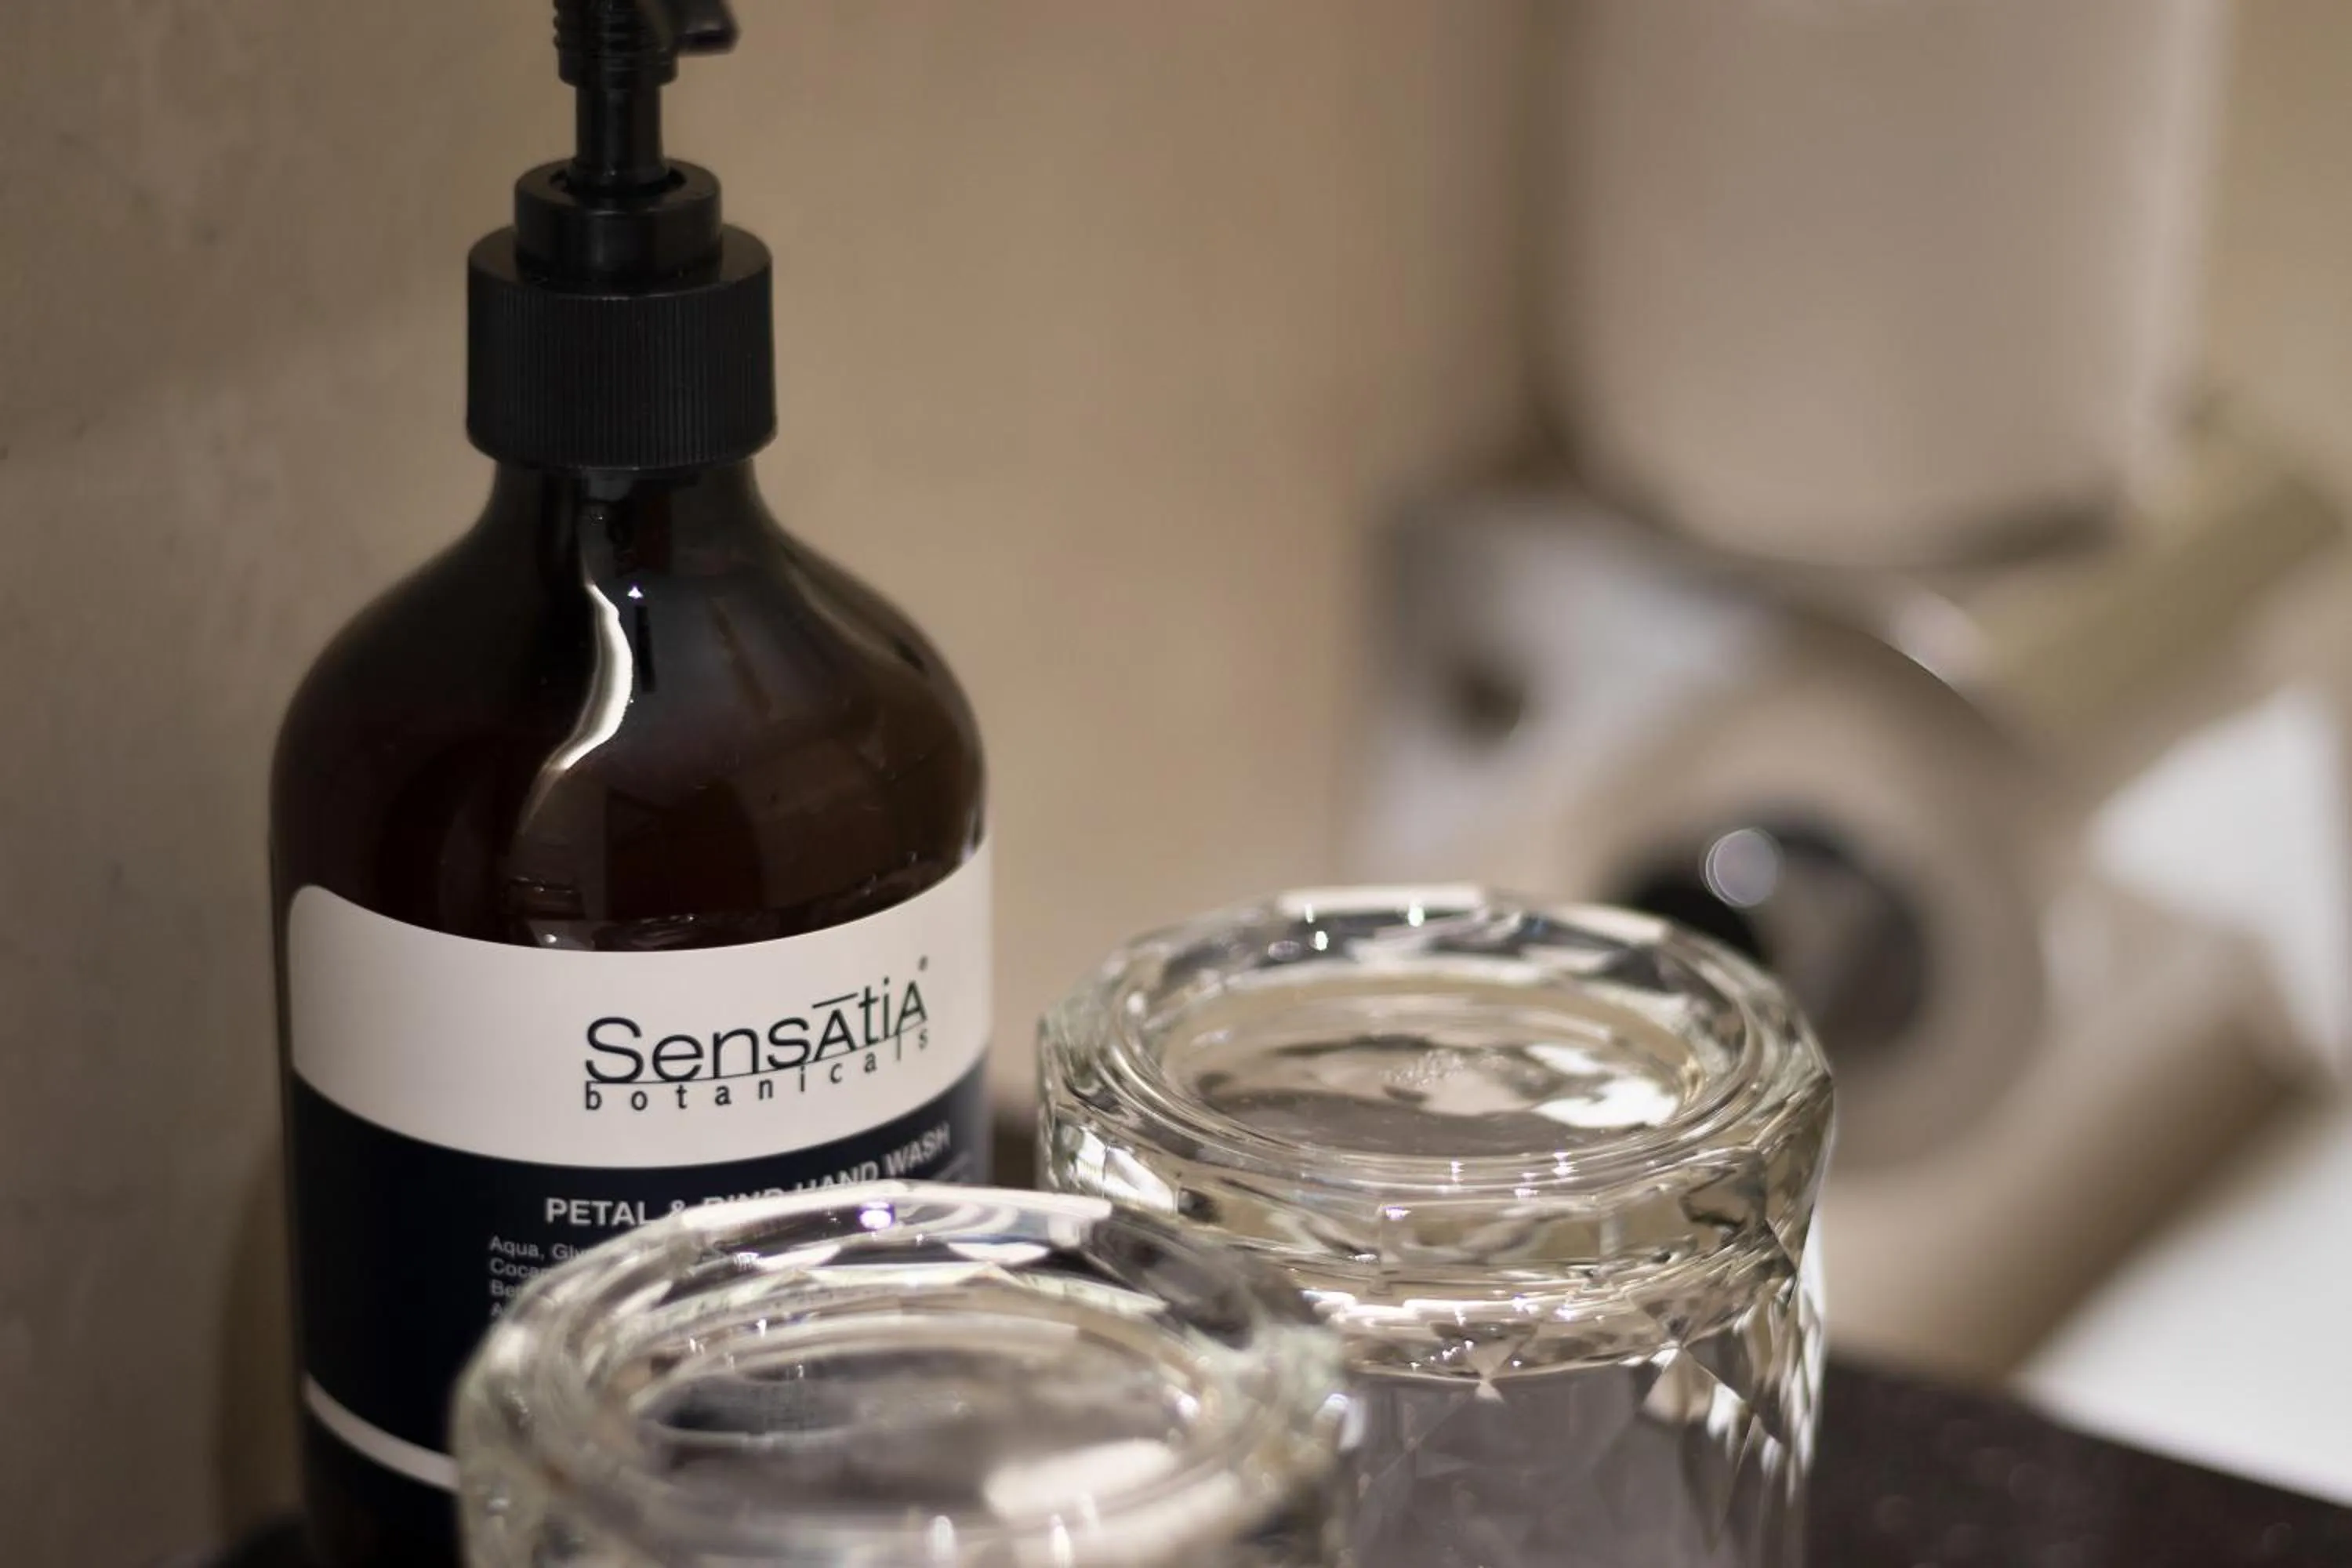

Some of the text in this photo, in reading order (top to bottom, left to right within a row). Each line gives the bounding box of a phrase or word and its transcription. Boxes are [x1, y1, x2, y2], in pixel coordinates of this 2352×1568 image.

[585, 1029, 927, 1111] botanicals
[546, 1197, 652, 1226] PETAL
[883, 1121, 951, 1176] WASH
[489, 1236, 545, 1261] Aqua,
